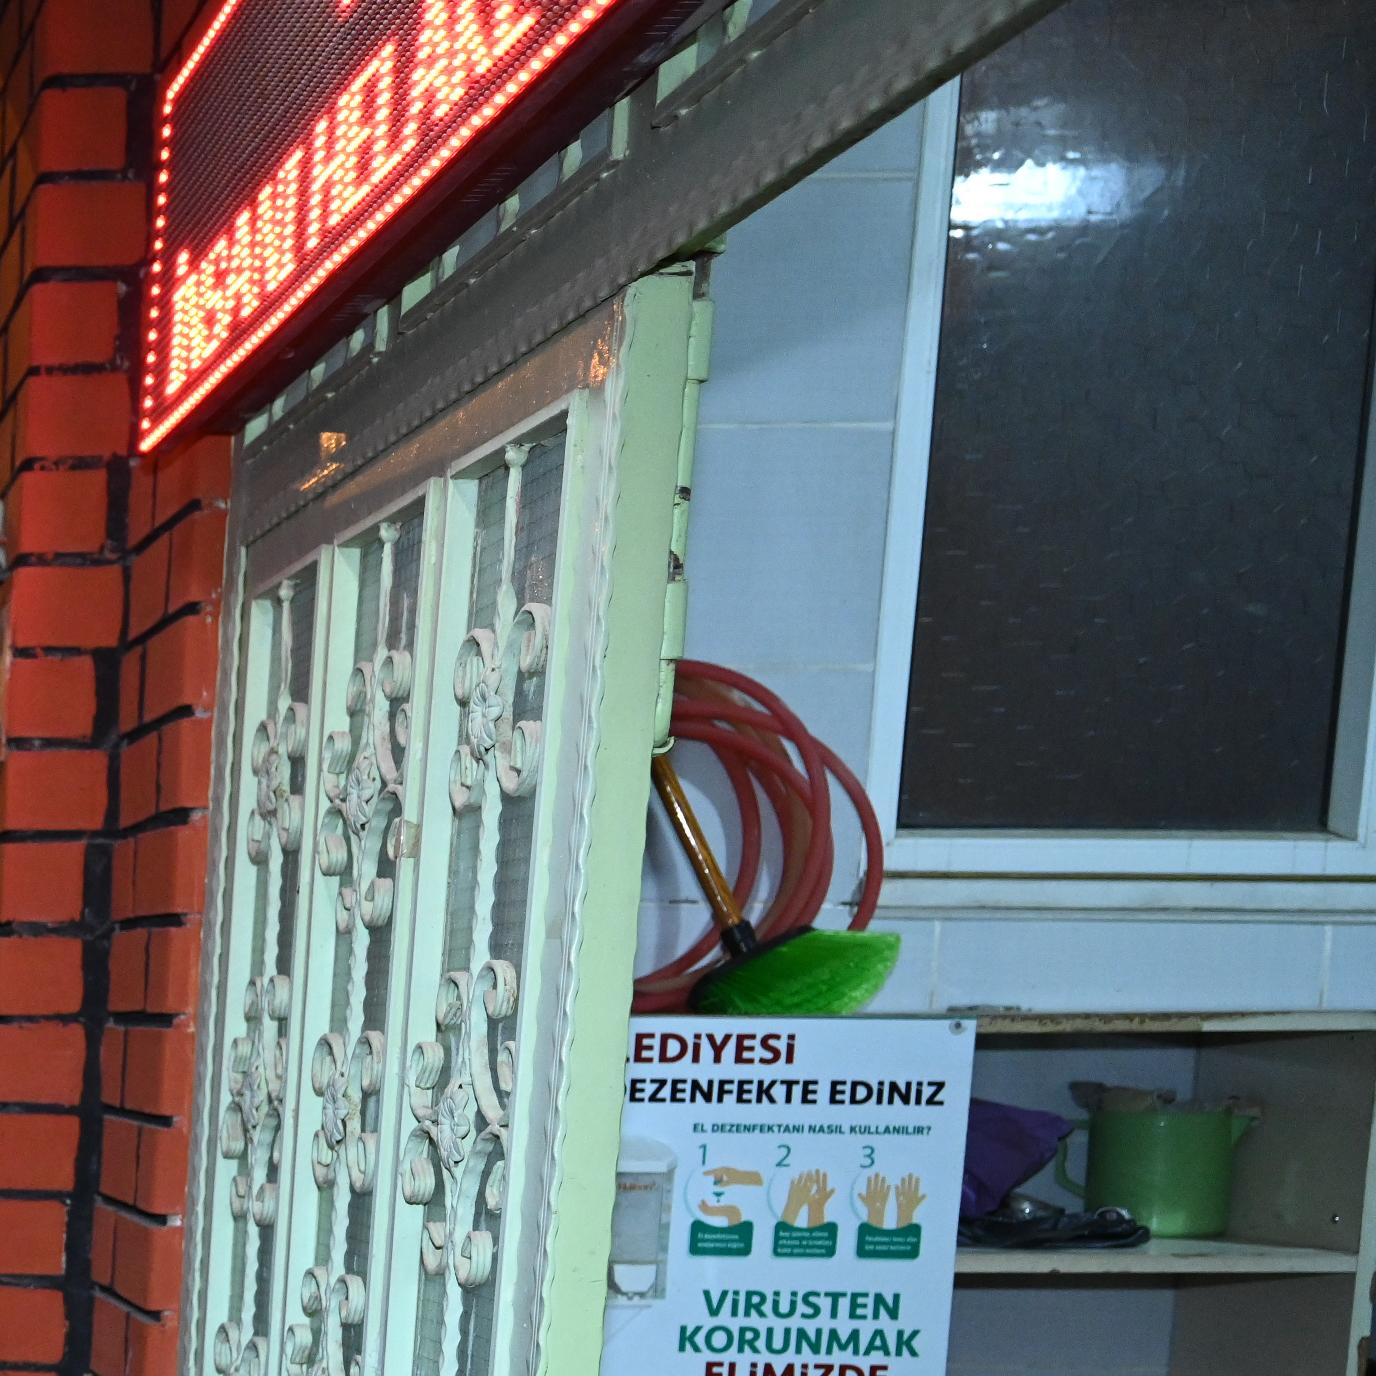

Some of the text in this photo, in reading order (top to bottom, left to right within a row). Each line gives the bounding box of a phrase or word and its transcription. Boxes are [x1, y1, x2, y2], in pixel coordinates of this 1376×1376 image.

[627, 1032, 796, 1065] EDİYESİ
[624, 1078, 817, 1105] EZENFEKTE
[692, 1122, 932, 1137] EL DEZENFEKTANI NASIL KULLANILIR?
[697, 1143, 876, 1168] 1 2 3
[677, 1325, 921, 1358] KORUNMAK
